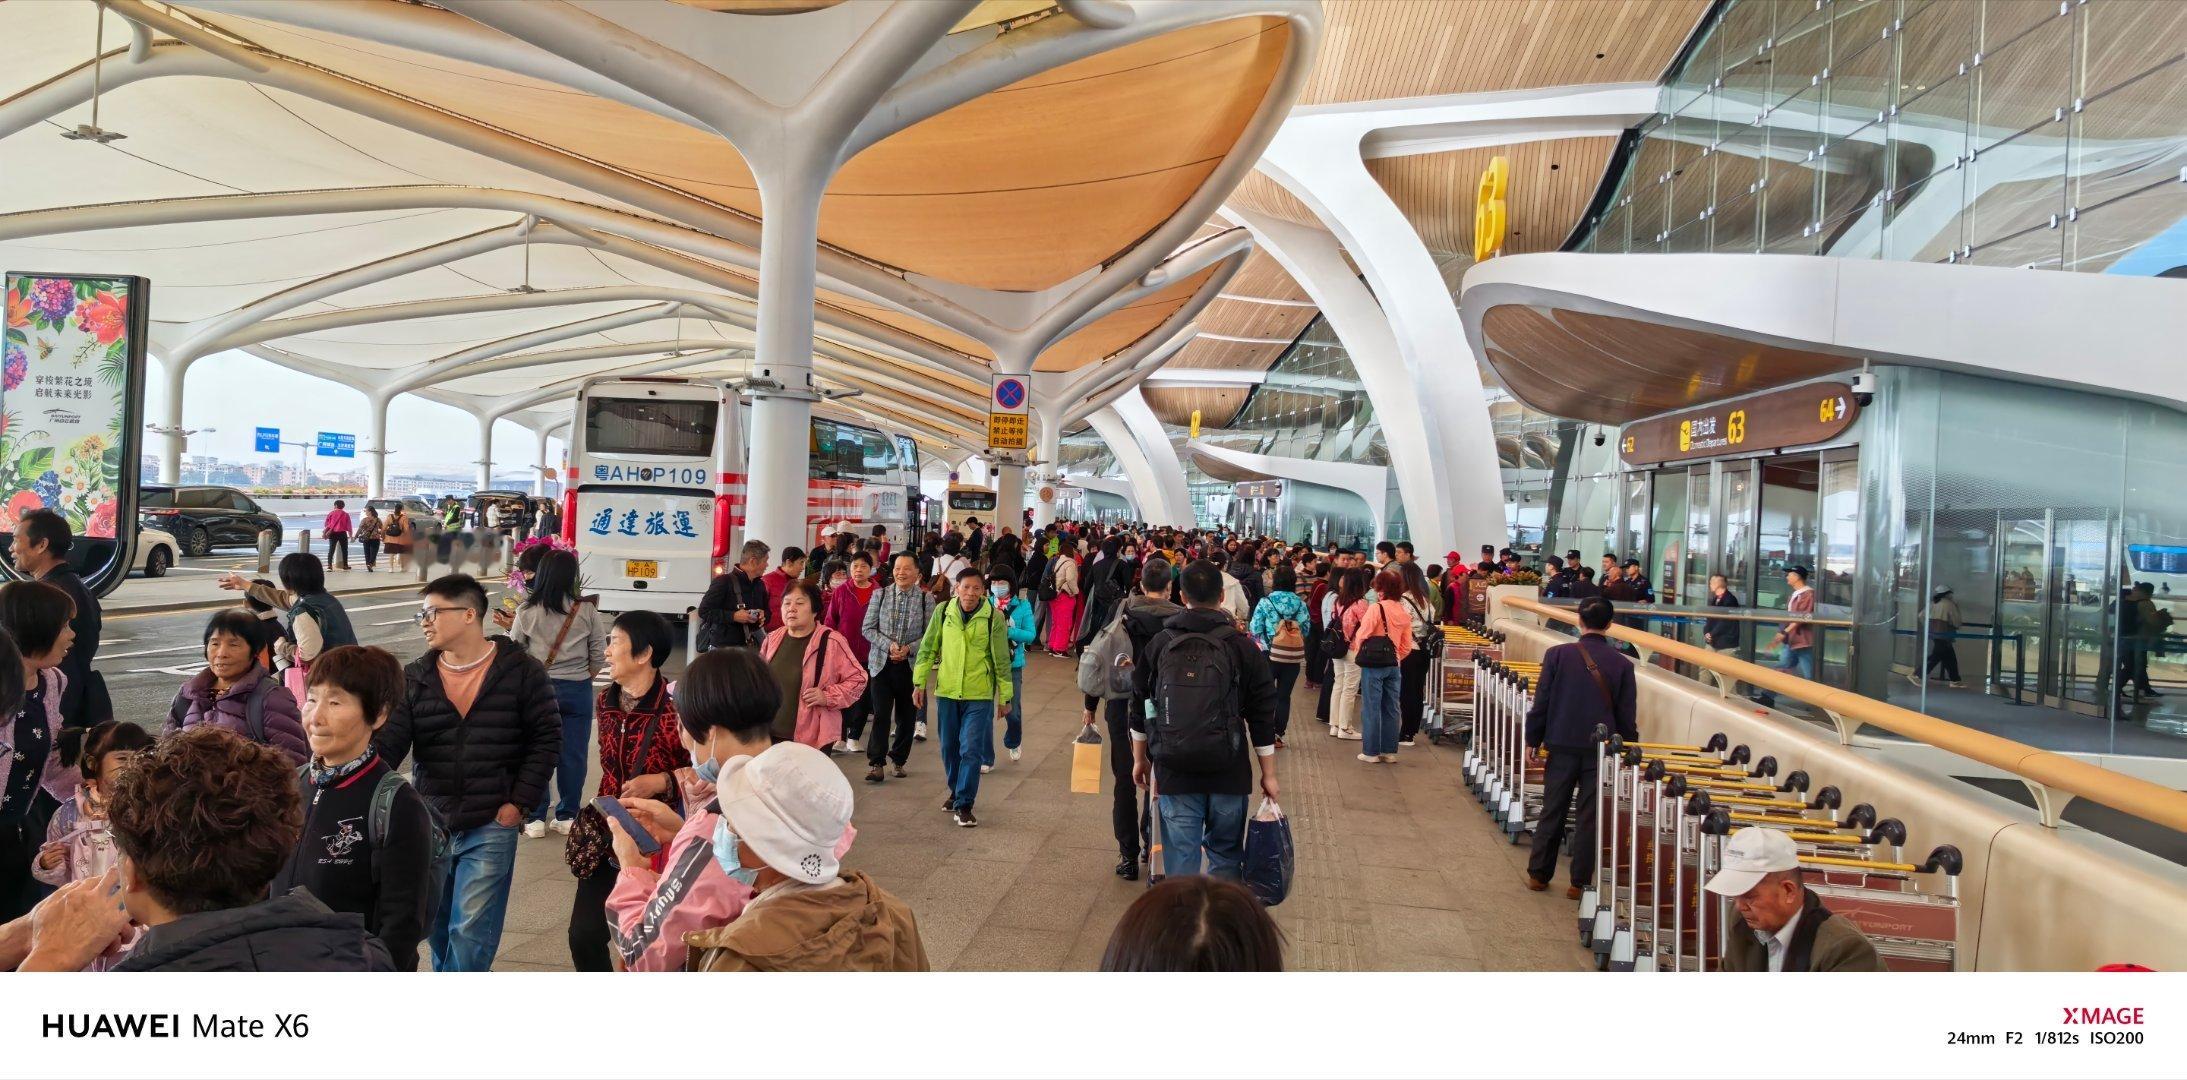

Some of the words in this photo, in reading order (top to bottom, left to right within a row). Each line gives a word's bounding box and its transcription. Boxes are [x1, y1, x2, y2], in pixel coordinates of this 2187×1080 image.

[1474, 156, 1509, 263] 63
[35, 374, 93, 387] 穿梭繁花之境
[35, 387, 92, 400] 启航未来光影
[1819, 398, 1835, 423] 64
[993, 416, 1025, 425] 即停即走
[1728, 410, 1745, 444] 63
[993, 426, 1024, 436] 禁止等待
[588, 507, 699, 538] 通達旅運
[627, 567, 656, 577] HP109
